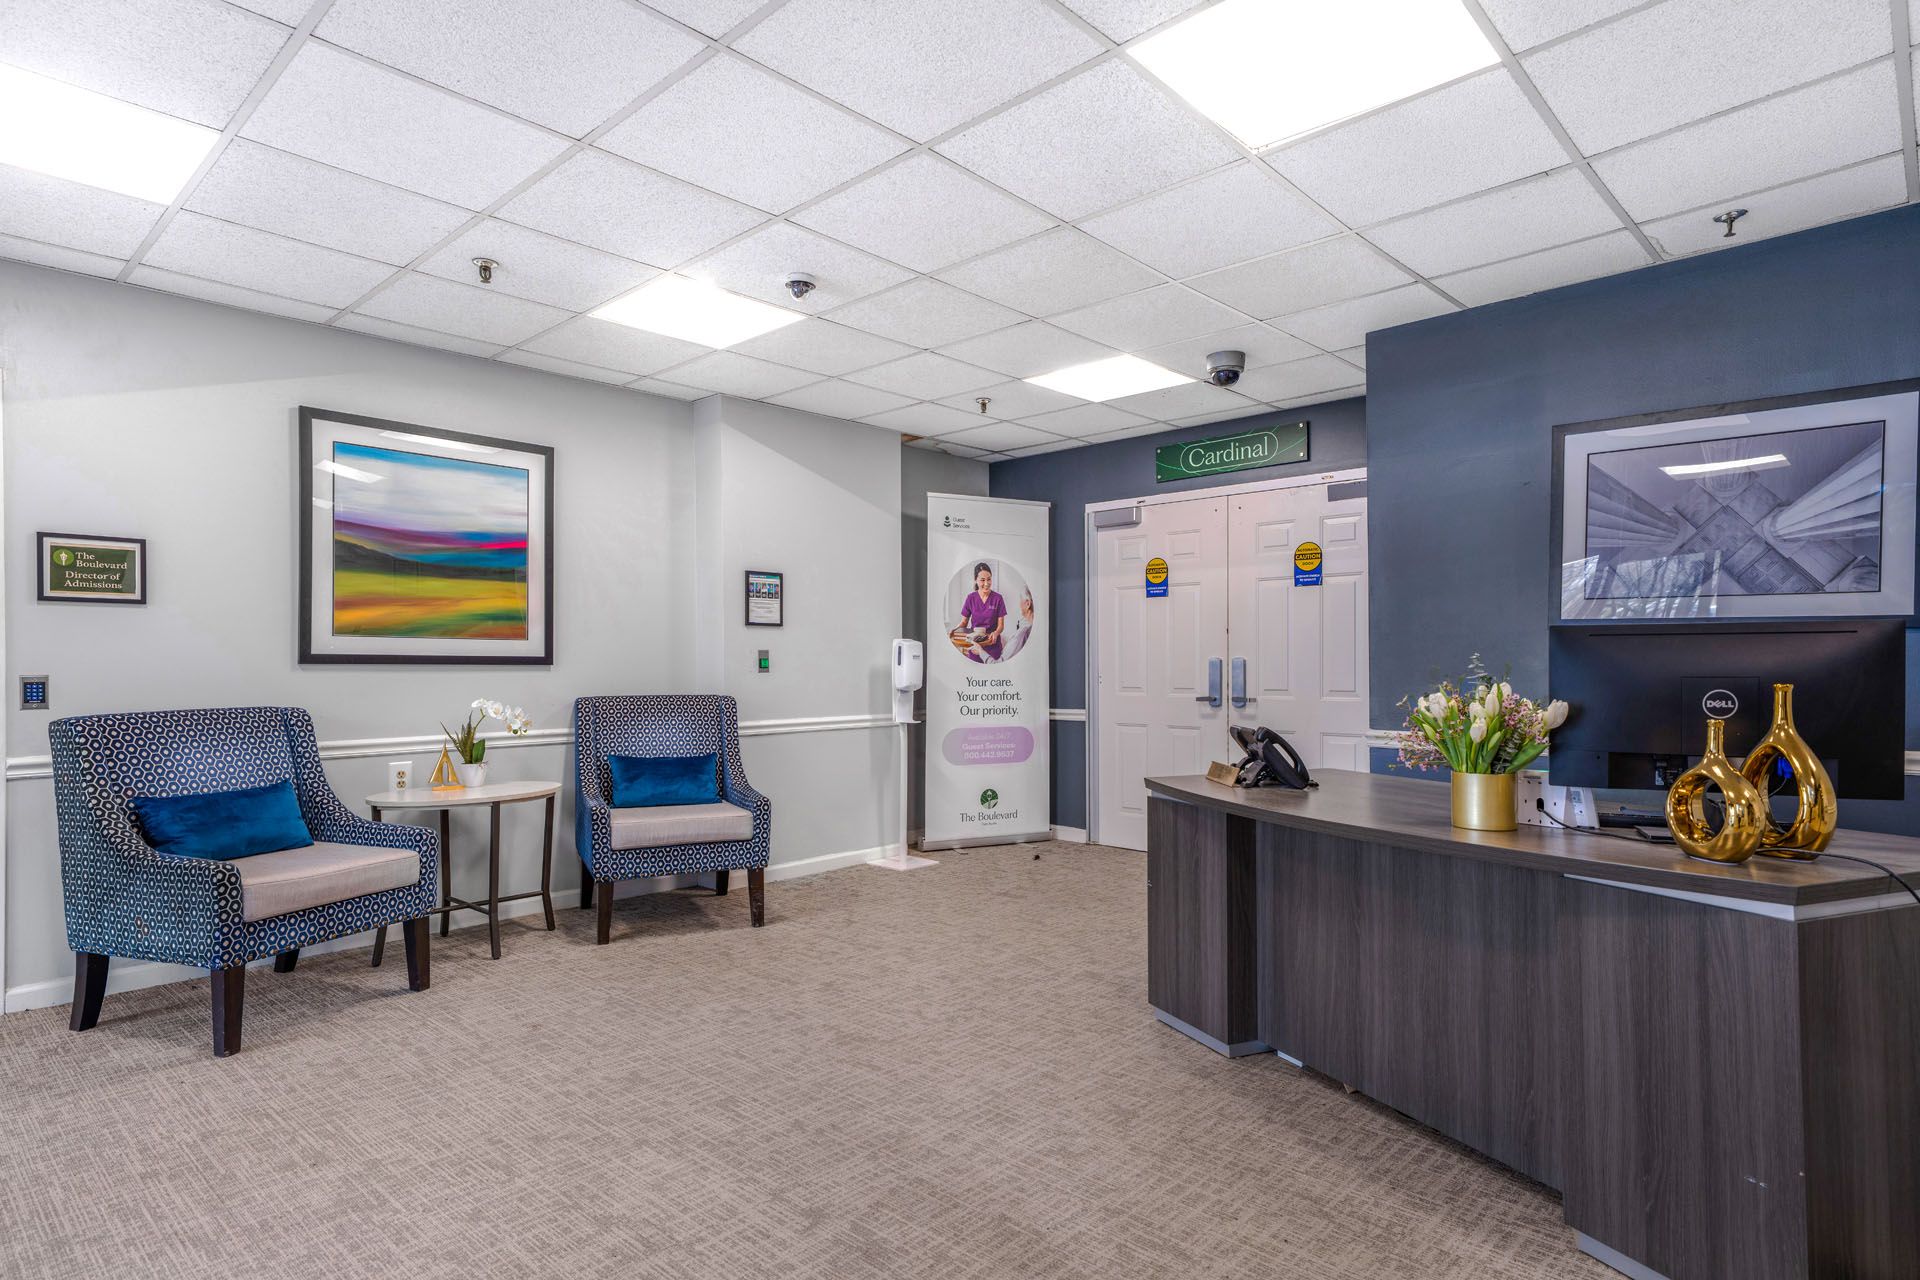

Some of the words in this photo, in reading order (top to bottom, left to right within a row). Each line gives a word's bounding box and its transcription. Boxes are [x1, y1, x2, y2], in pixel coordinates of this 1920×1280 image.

[1188, 436, 1269, 467] Cardinal
[75, 551, 95, 560] The
[76, 560, 127, 569] Boulevard
[65, 570, 108, 579] Director
[64, 579, 122, 589] Admissions
[966, 676, 988, 687] Your
[990, 679, 1014, 687] care.
[956, 690, 979, 701] Your
[980, 690, 1022, 701] comfort.
[1706, 699, 1734, 708] DELL
[960, 705, 980, 716] Our
[982, 704, 1019, 718] priority.
[960, 812, 976, 822] The
[978, 809, 1018, 821] Boulevard
